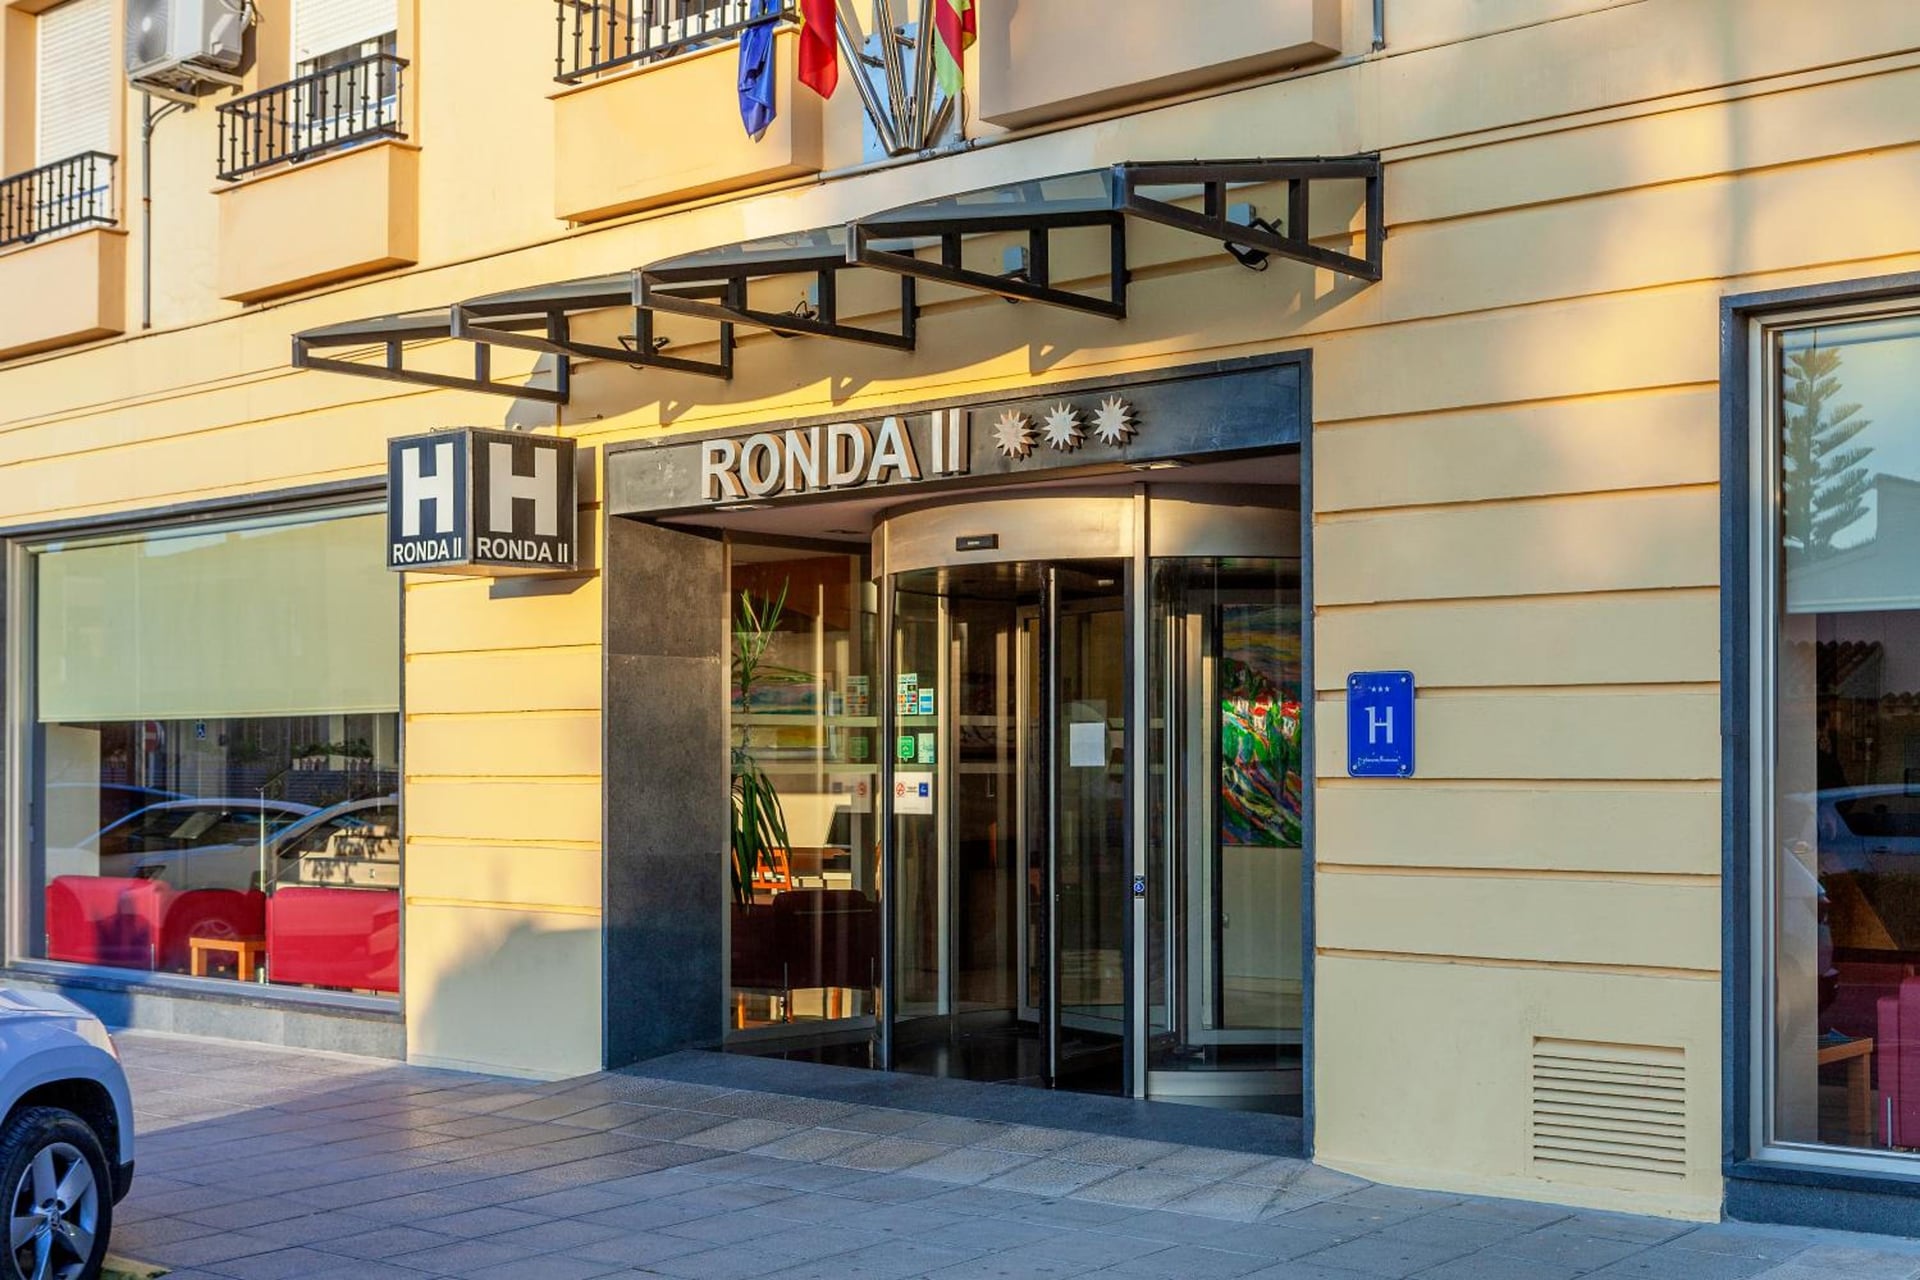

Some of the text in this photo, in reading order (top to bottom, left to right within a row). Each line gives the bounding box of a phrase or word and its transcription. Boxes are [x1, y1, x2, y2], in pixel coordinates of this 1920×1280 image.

[701, 408, 970, 500] RONDA II
[402, 442, 454, 537] H
[489, 442, 558, 536] H
[393, 537, 462, 564] RONDA II
[477, 537, 568, 563] RONDA II
[1364, 706, 1394, 744] H
